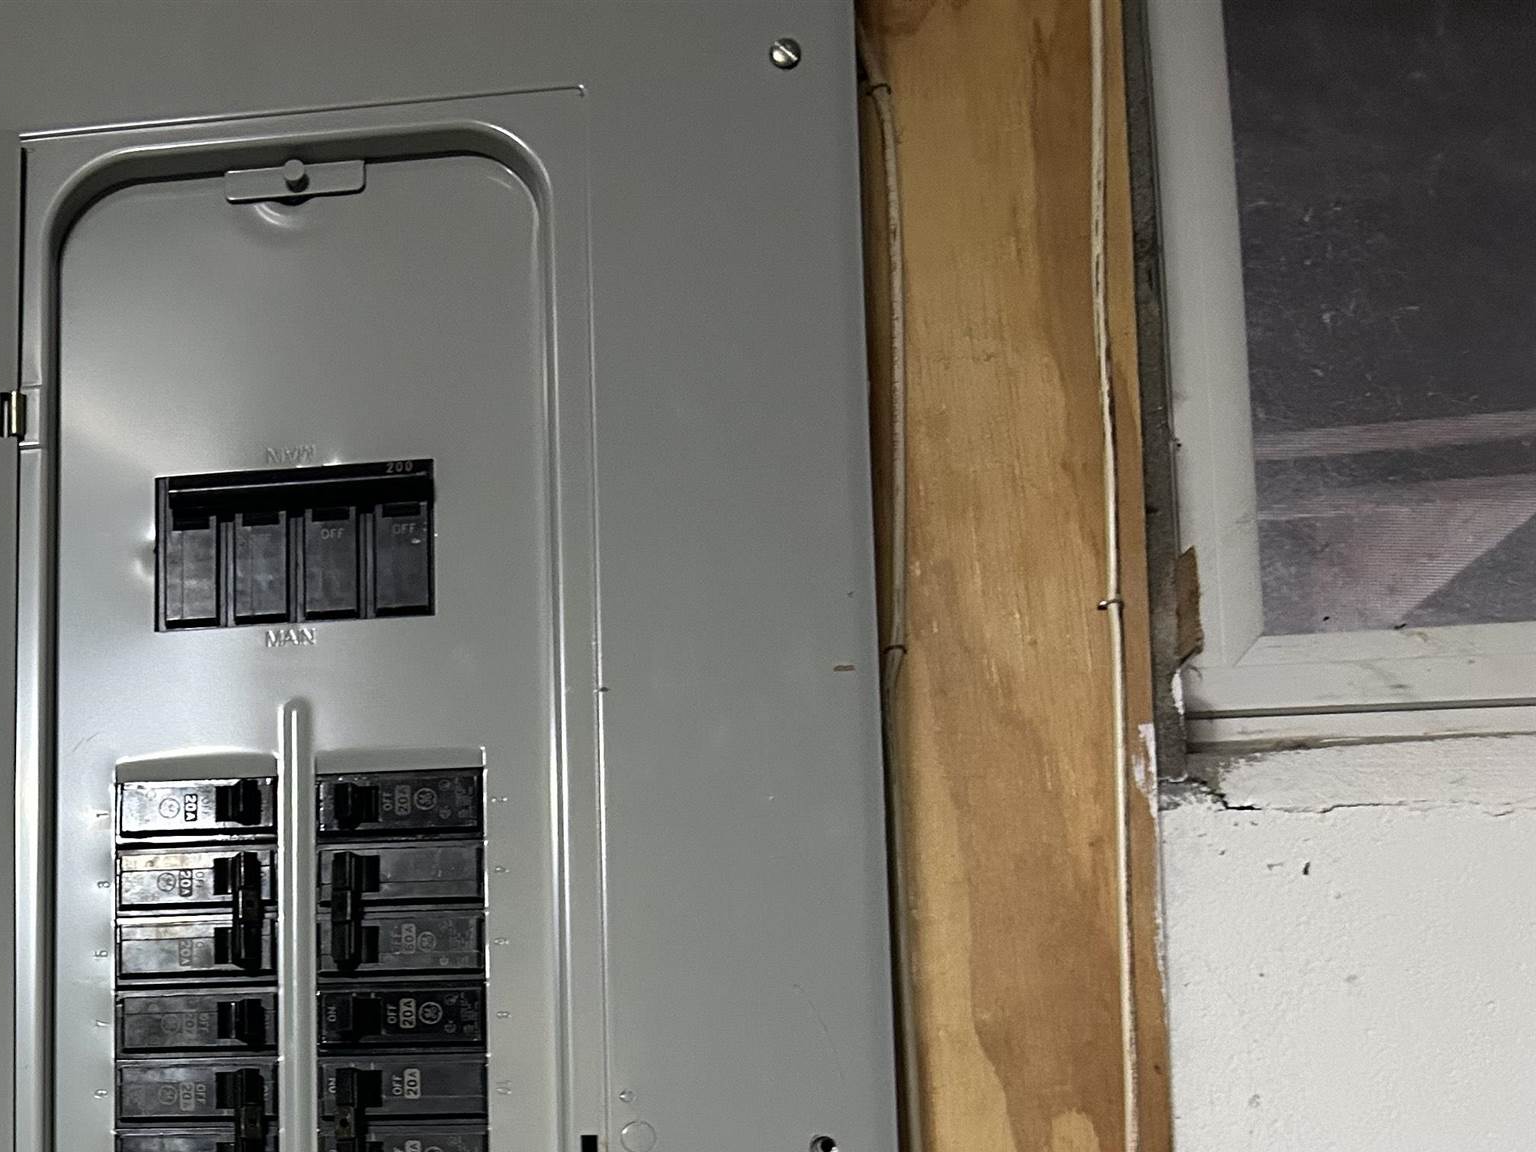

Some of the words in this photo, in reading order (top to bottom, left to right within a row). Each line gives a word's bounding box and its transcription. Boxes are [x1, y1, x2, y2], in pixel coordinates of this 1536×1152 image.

[386, 460, 414, 474] 200
[320, 527, 345, 540] OFF
[392, 522, 415, 535] OFF
[184, 793, 198, 822] 20A
[395, 785, 411, 816] 20A
[179, 869, 192, 897] 20A
[327, 1005, 337, 1023] ON
[387, 1005, 397, 1024] OFF
[400, 998, 416, 1029] 20A
[392, 1075, 402, 1096] OFF
[404, 1068, 421, 1099] 20A
[180, 1082, 195, 1112] 20A
[196, 1084, 207, 1105] OFF
